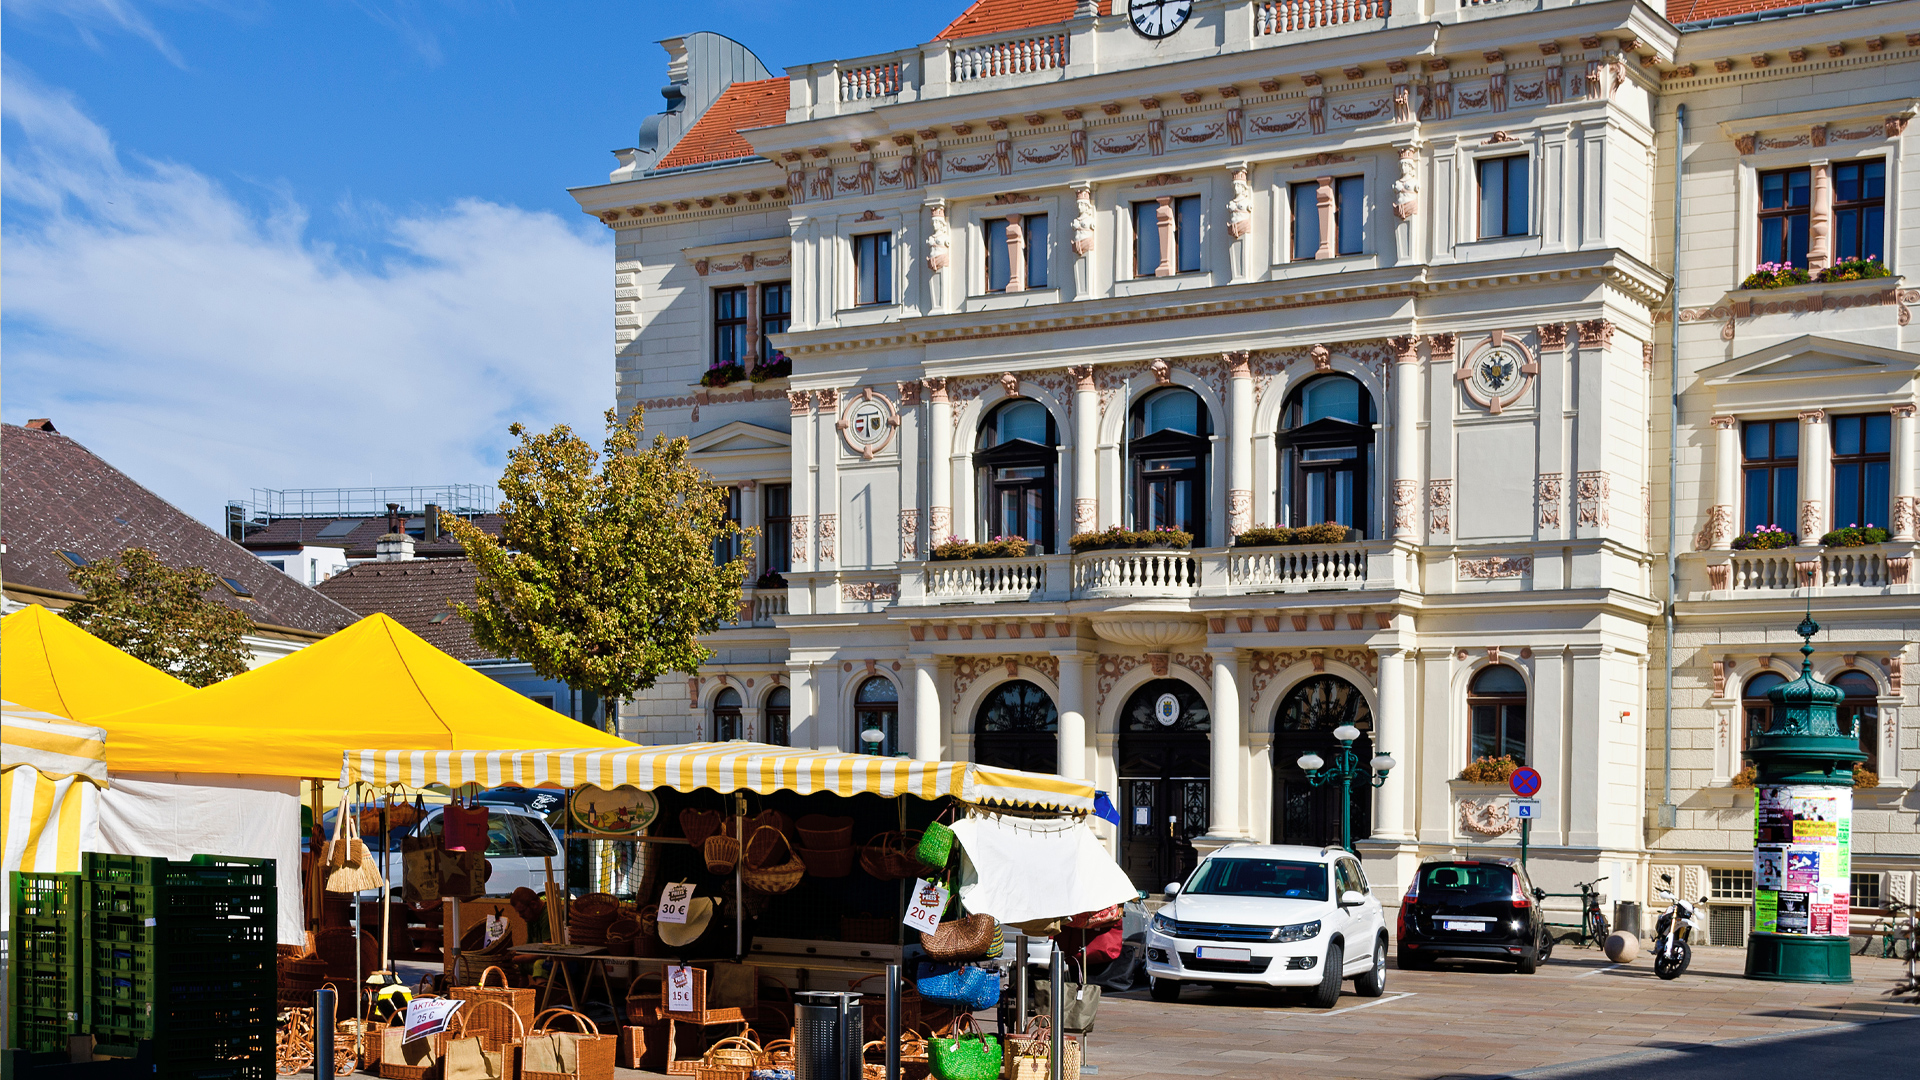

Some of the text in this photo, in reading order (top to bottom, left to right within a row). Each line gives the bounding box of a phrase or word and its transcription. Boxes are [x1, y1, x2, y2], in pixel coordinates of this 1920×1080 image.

[662, 904, 686, 915] 30 €
[910, 906, 926, 920] 20
[928, 914, 937, 925] €
[672, 991, 690, 1001] 15 €
[412, 1001, 446, 1011] AKTION
[416, 1012, 427, 1024] 25
[428, 1011, 435, 1020] €
